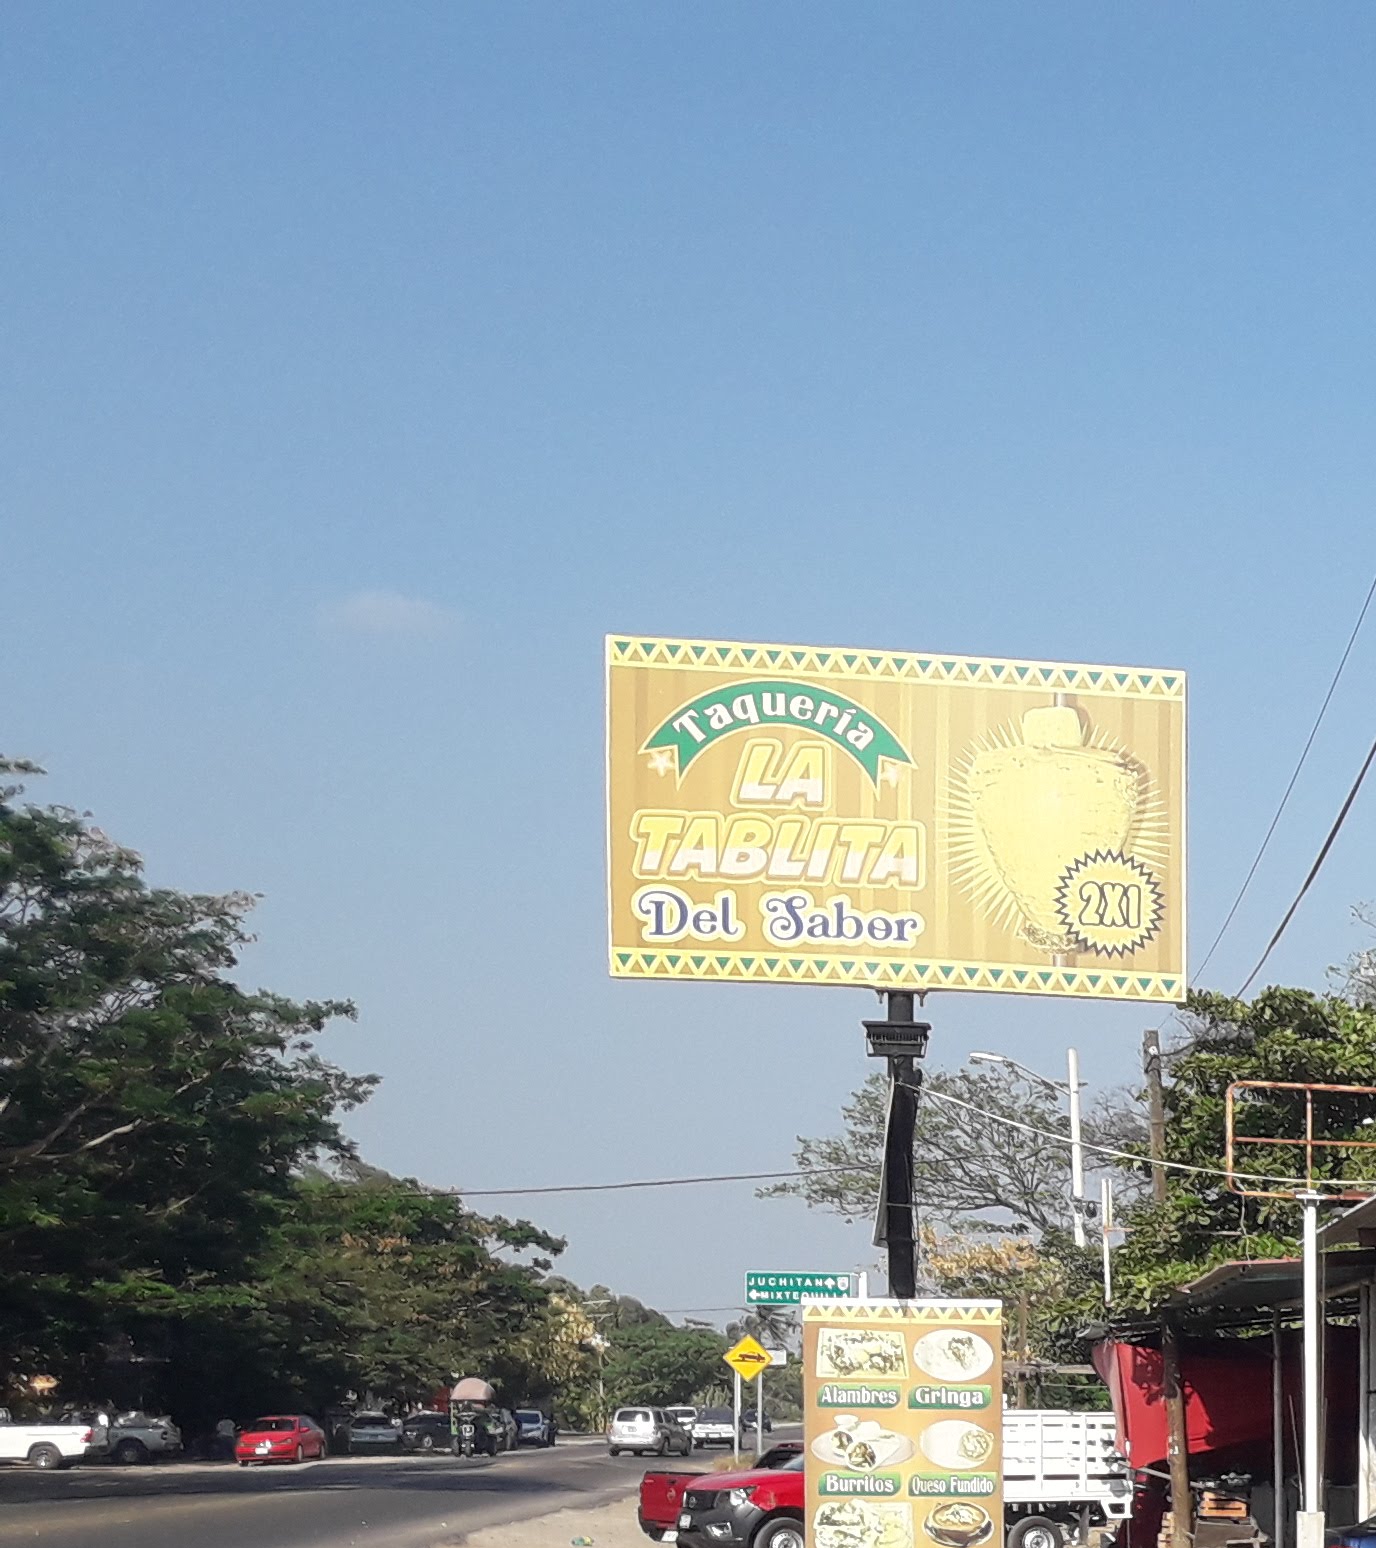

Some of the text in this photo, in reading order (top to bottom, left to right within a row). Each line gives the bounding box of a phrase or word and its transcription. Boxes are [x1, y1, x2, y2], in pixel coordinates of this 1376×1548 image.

[672, 692, 875, 751] Taquería
[735, 741, 827, 806] LA
[635, 813, 921, 887] TABLITA
[638, 890, 918, 942] Del Sabor
[748, 1276, 824, 1287] JUCHITAN
[821, 1386, 897, 1404] Alambres
[915, 1388, 983, 1407] Gringa
[826, 1475, 894, 1493] Burritos
[912, 1476, 993, 1495] Queso Fundido
